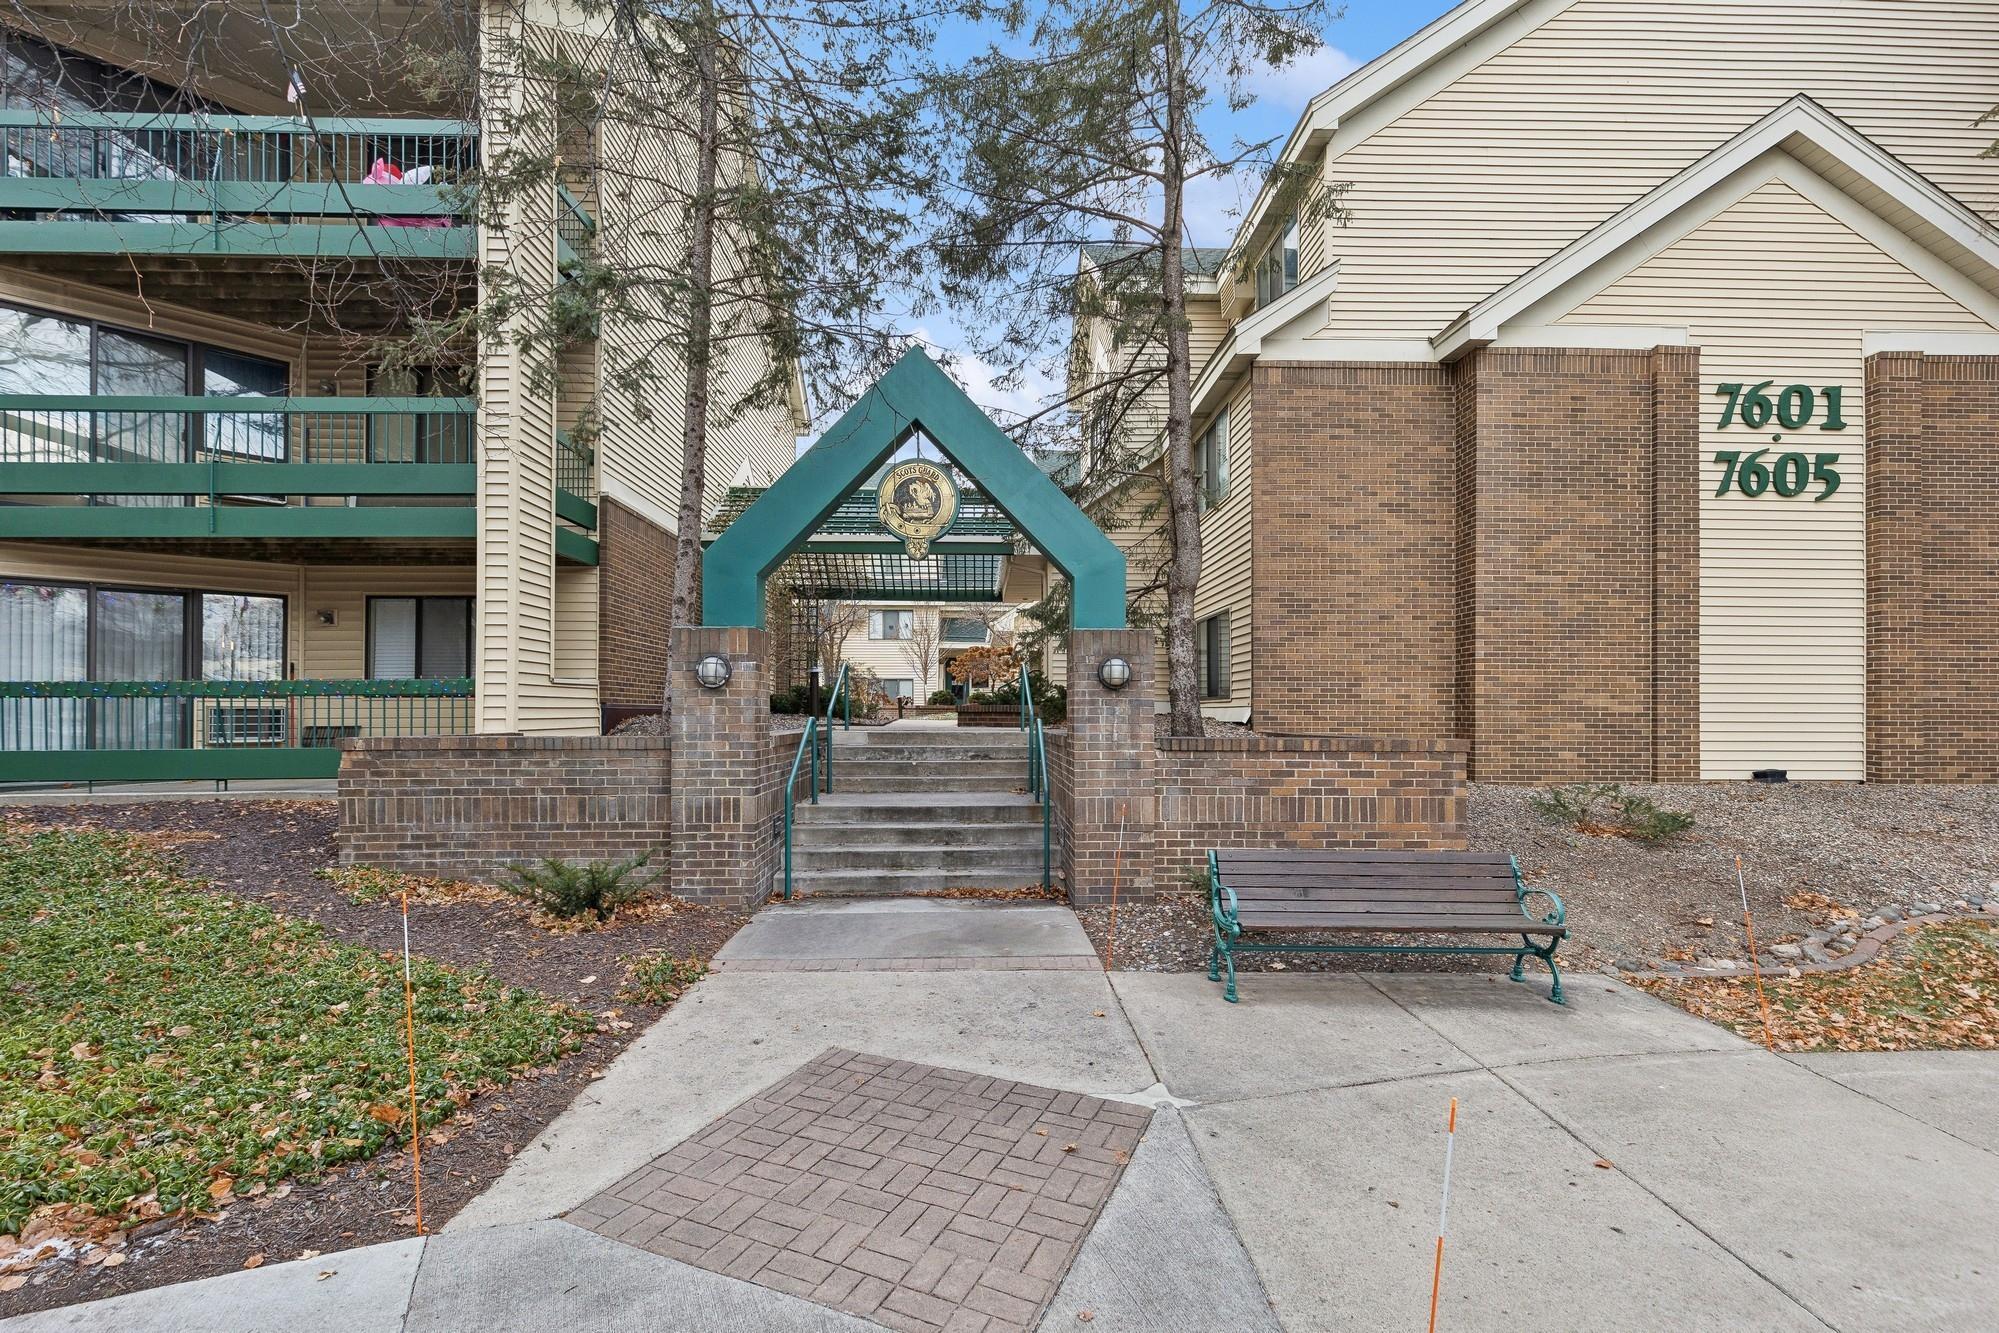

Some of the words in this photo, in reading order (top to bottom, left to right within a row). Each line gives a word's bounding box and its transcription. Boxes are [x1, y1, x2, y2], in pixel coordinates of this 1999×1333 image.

[1715, 380, 1847, 430] 7601
[896, 467, 917, 480] SCOTS
[918, 467, 940, 481] GUARD
[1713, 448, 1841, 502] 7605
